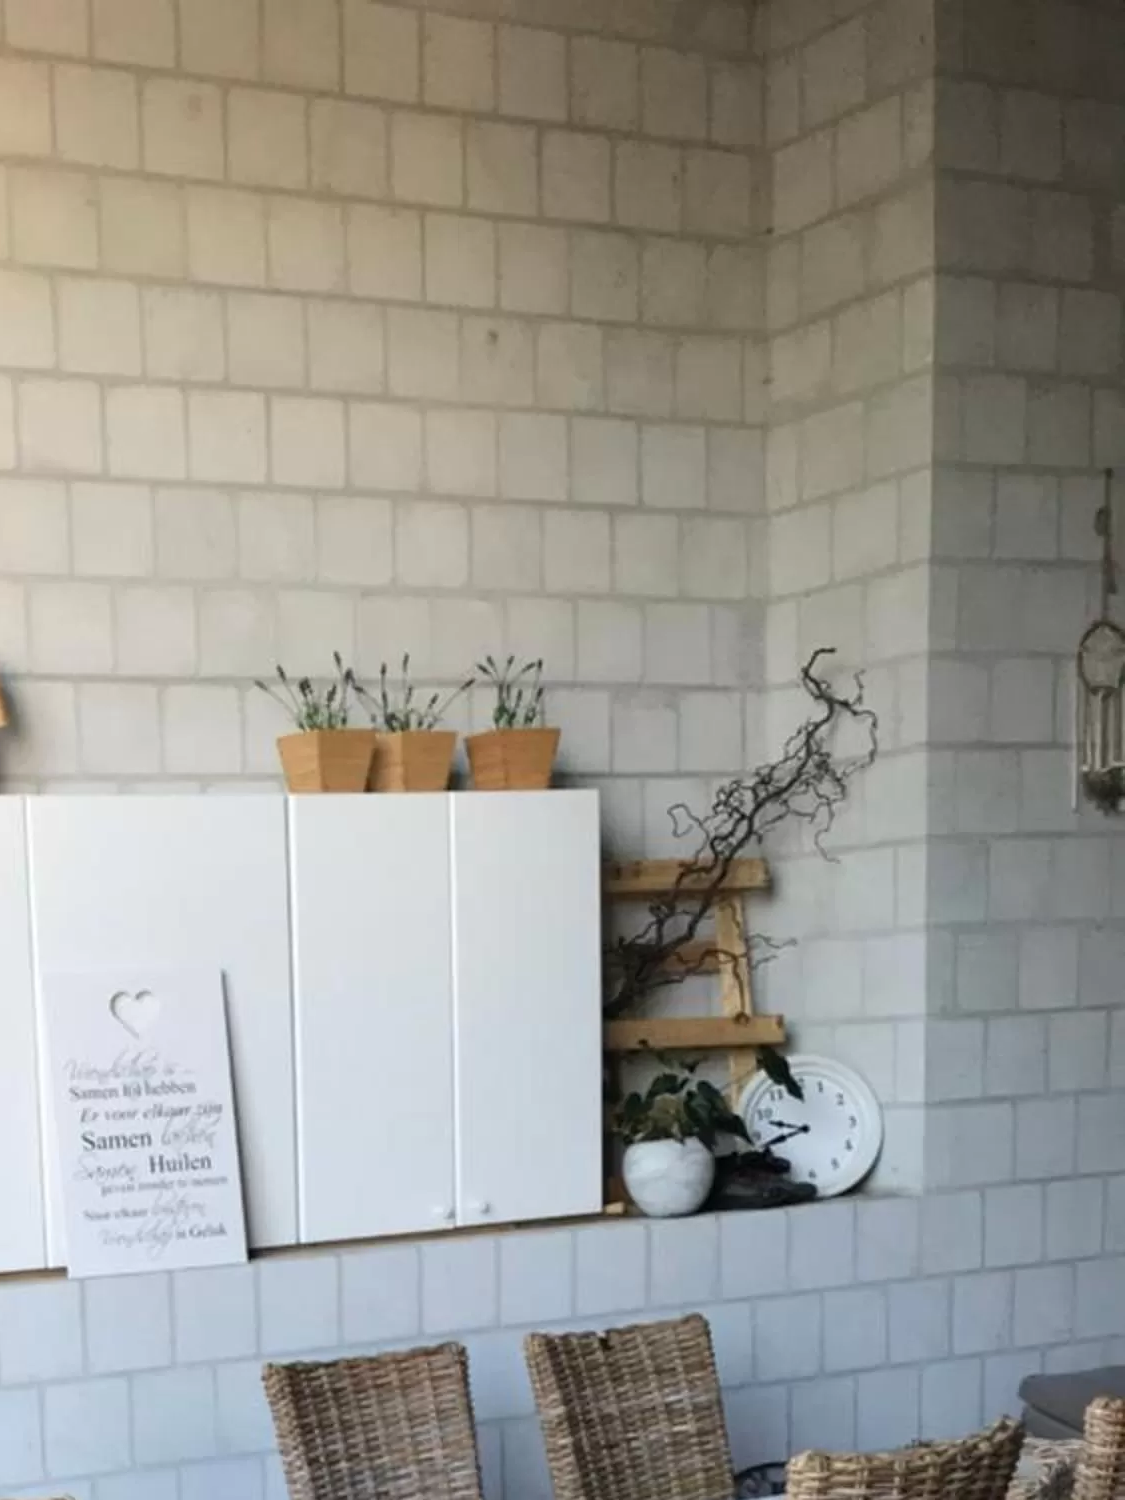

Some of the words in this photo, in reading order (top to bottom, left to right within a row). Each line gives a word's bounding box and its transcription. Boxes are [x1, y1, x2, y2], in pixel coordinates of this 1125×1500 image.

[68, 1085, 119, 1101] Samen
[144, 1079, 196, 1096] hebben
[80, 1108, 99, 1123] Er
[104, 1107, 138, 1121] voor
[81, 1131, 152, 1151] Samen
[149, 1153, 212, 1174] Huilen
